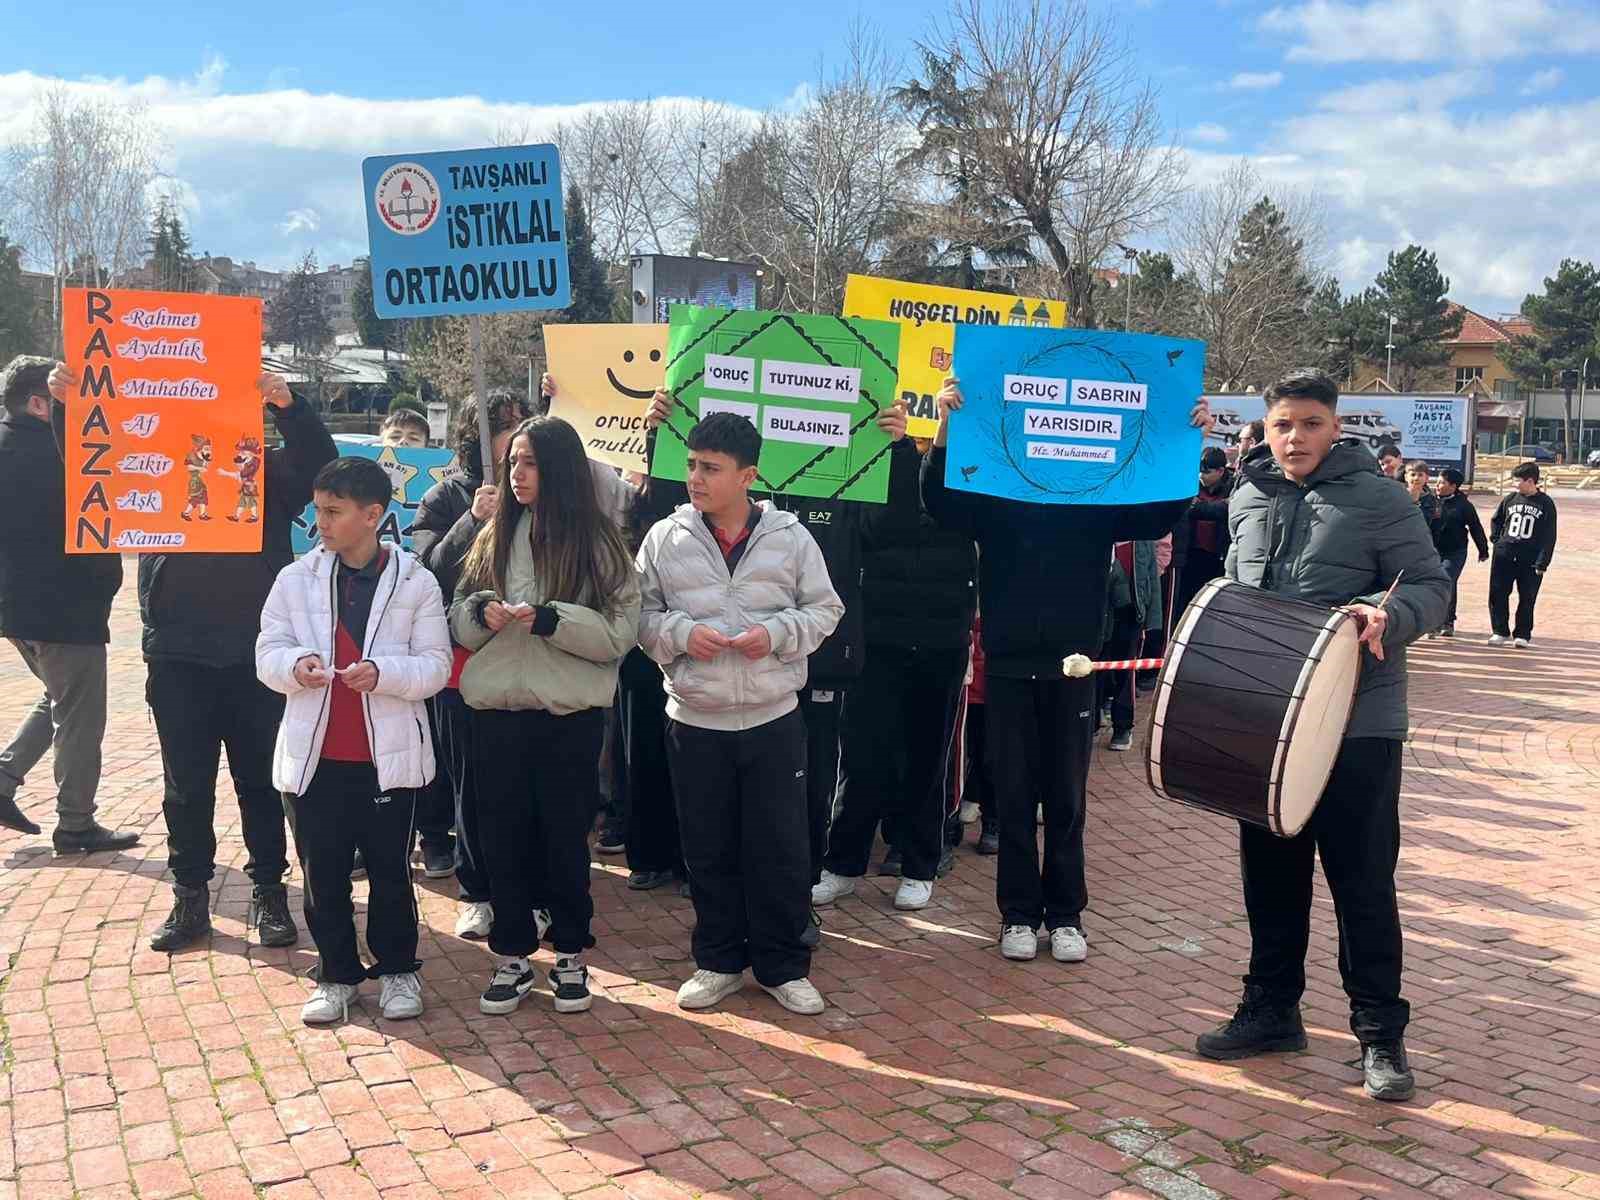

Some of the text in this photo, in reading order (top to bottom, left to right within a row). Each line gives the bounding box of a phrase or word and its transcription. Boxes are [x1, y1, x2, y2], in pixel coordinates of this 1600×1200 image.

[449, 161, 547, 192] TAVŞANLI
[385, 258, 557, 306] ORTAOKULU
[890, 299, 1000, 327] HOŞGELDİN
[769, 372, 831, 389] TUTUNUZ
[835, 375, 854, 392] Kİ,
[1010, 382, 1141, 403] ORUÇ SABRIN
[901, 391, 939, 420] RA
[1414, 412, 1452, 420] HASTA
[76, 291, 116, 549] RAMAZAN
[1029, 415, 1118, 434] YARISIDIR.
[1053, 446, 1110, 459] Muhammed
[809, 511, 832, 520] EA7
[1508, 504, 1543, 519] NEW YORK
[1508, 512, 1536, 539] 80
